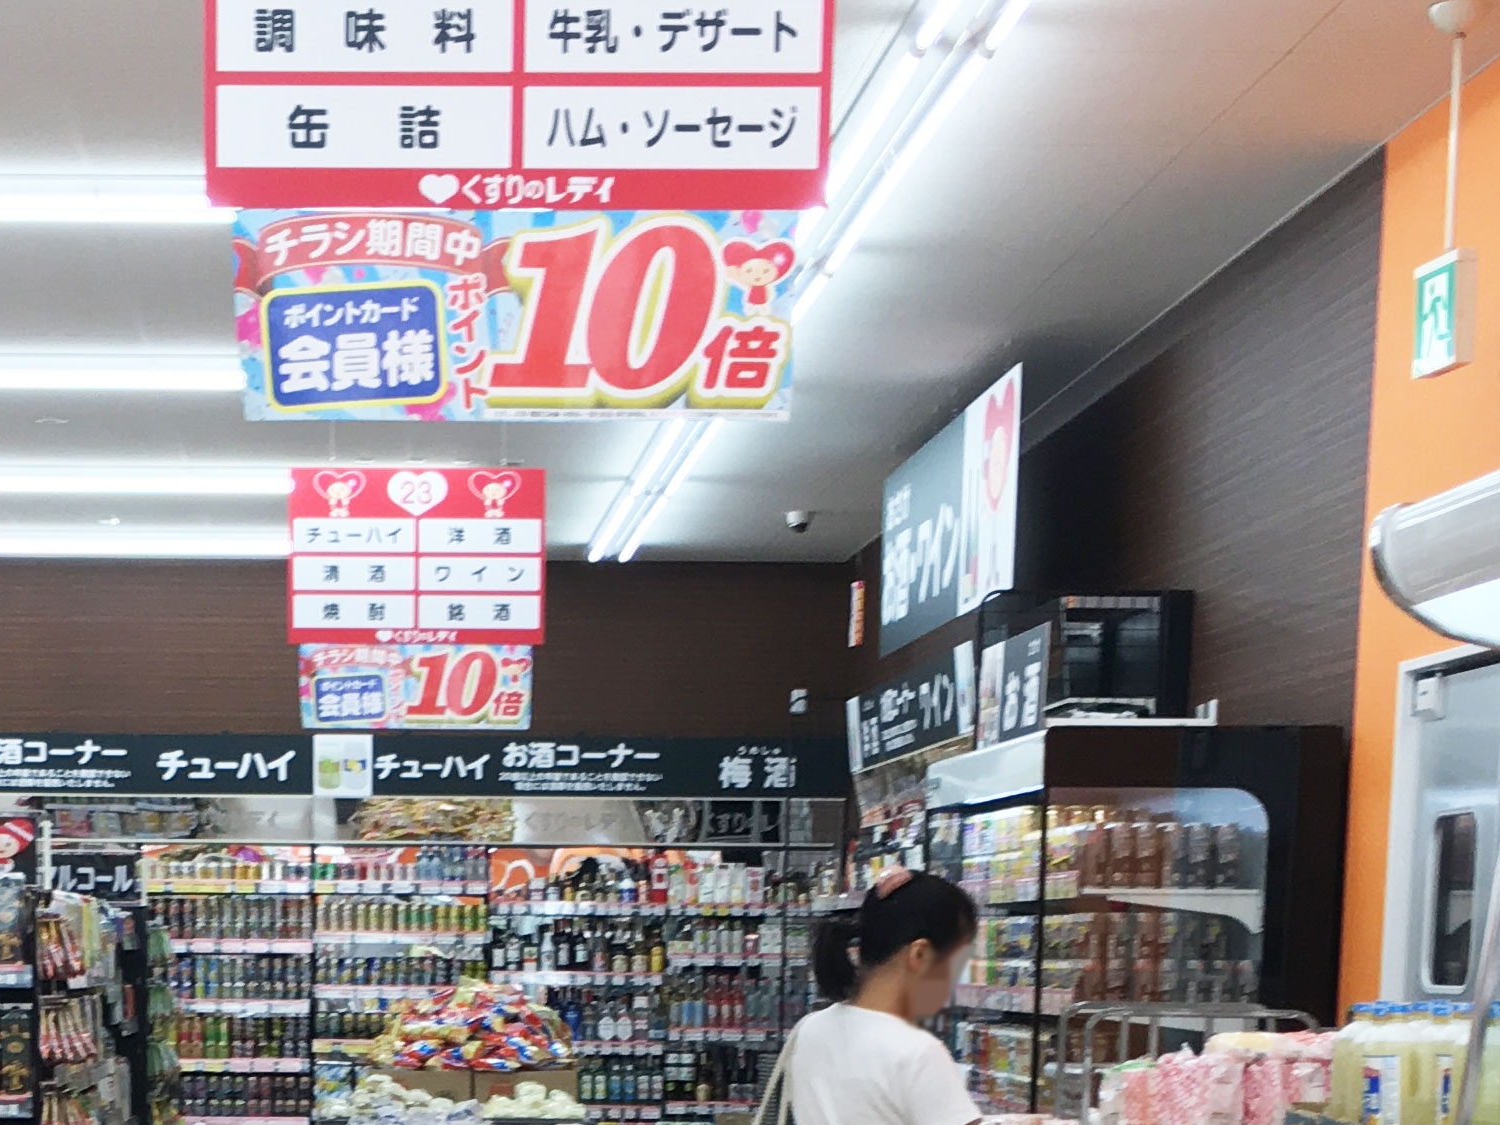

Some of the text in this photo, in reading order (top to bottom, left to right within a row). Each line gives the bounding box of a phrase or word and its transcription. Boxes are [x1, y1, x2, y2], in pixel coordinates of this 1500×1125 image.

[255, 7, 475, 53] 調味料
[547, 8, 798, 54] 牛乳・デザート
[287, 105, 440, 149] 缶詰
[546, 107, 799, 149] ハム・ソーセージ
[462, 175, 615, 204] くすりのレディ
[264, 219, 482, 263] チラシ期間中
[283, 298, 420, 328] ポイントカード
[489, 221, 719, 392] 10
[447, 277, 489, 410] ポイント
[702, 325, 780, 391] 倍
[278, 332, 436, 393] 会員様
[400, 480, 433, 504] 23
[307, 527, 402, 544] チューハイ
[448, 527, 512, 545] 洋酒
[322, 565, 386, 583] 清酒
[434, 565, 525, 583] ワイン
[407, 650, 497, 717] 10
[156, 750, 296, 782] チューハイ
[375, 752, 491, 782] チューハイ
[502, 742, 660, 768] お酒コーナー
